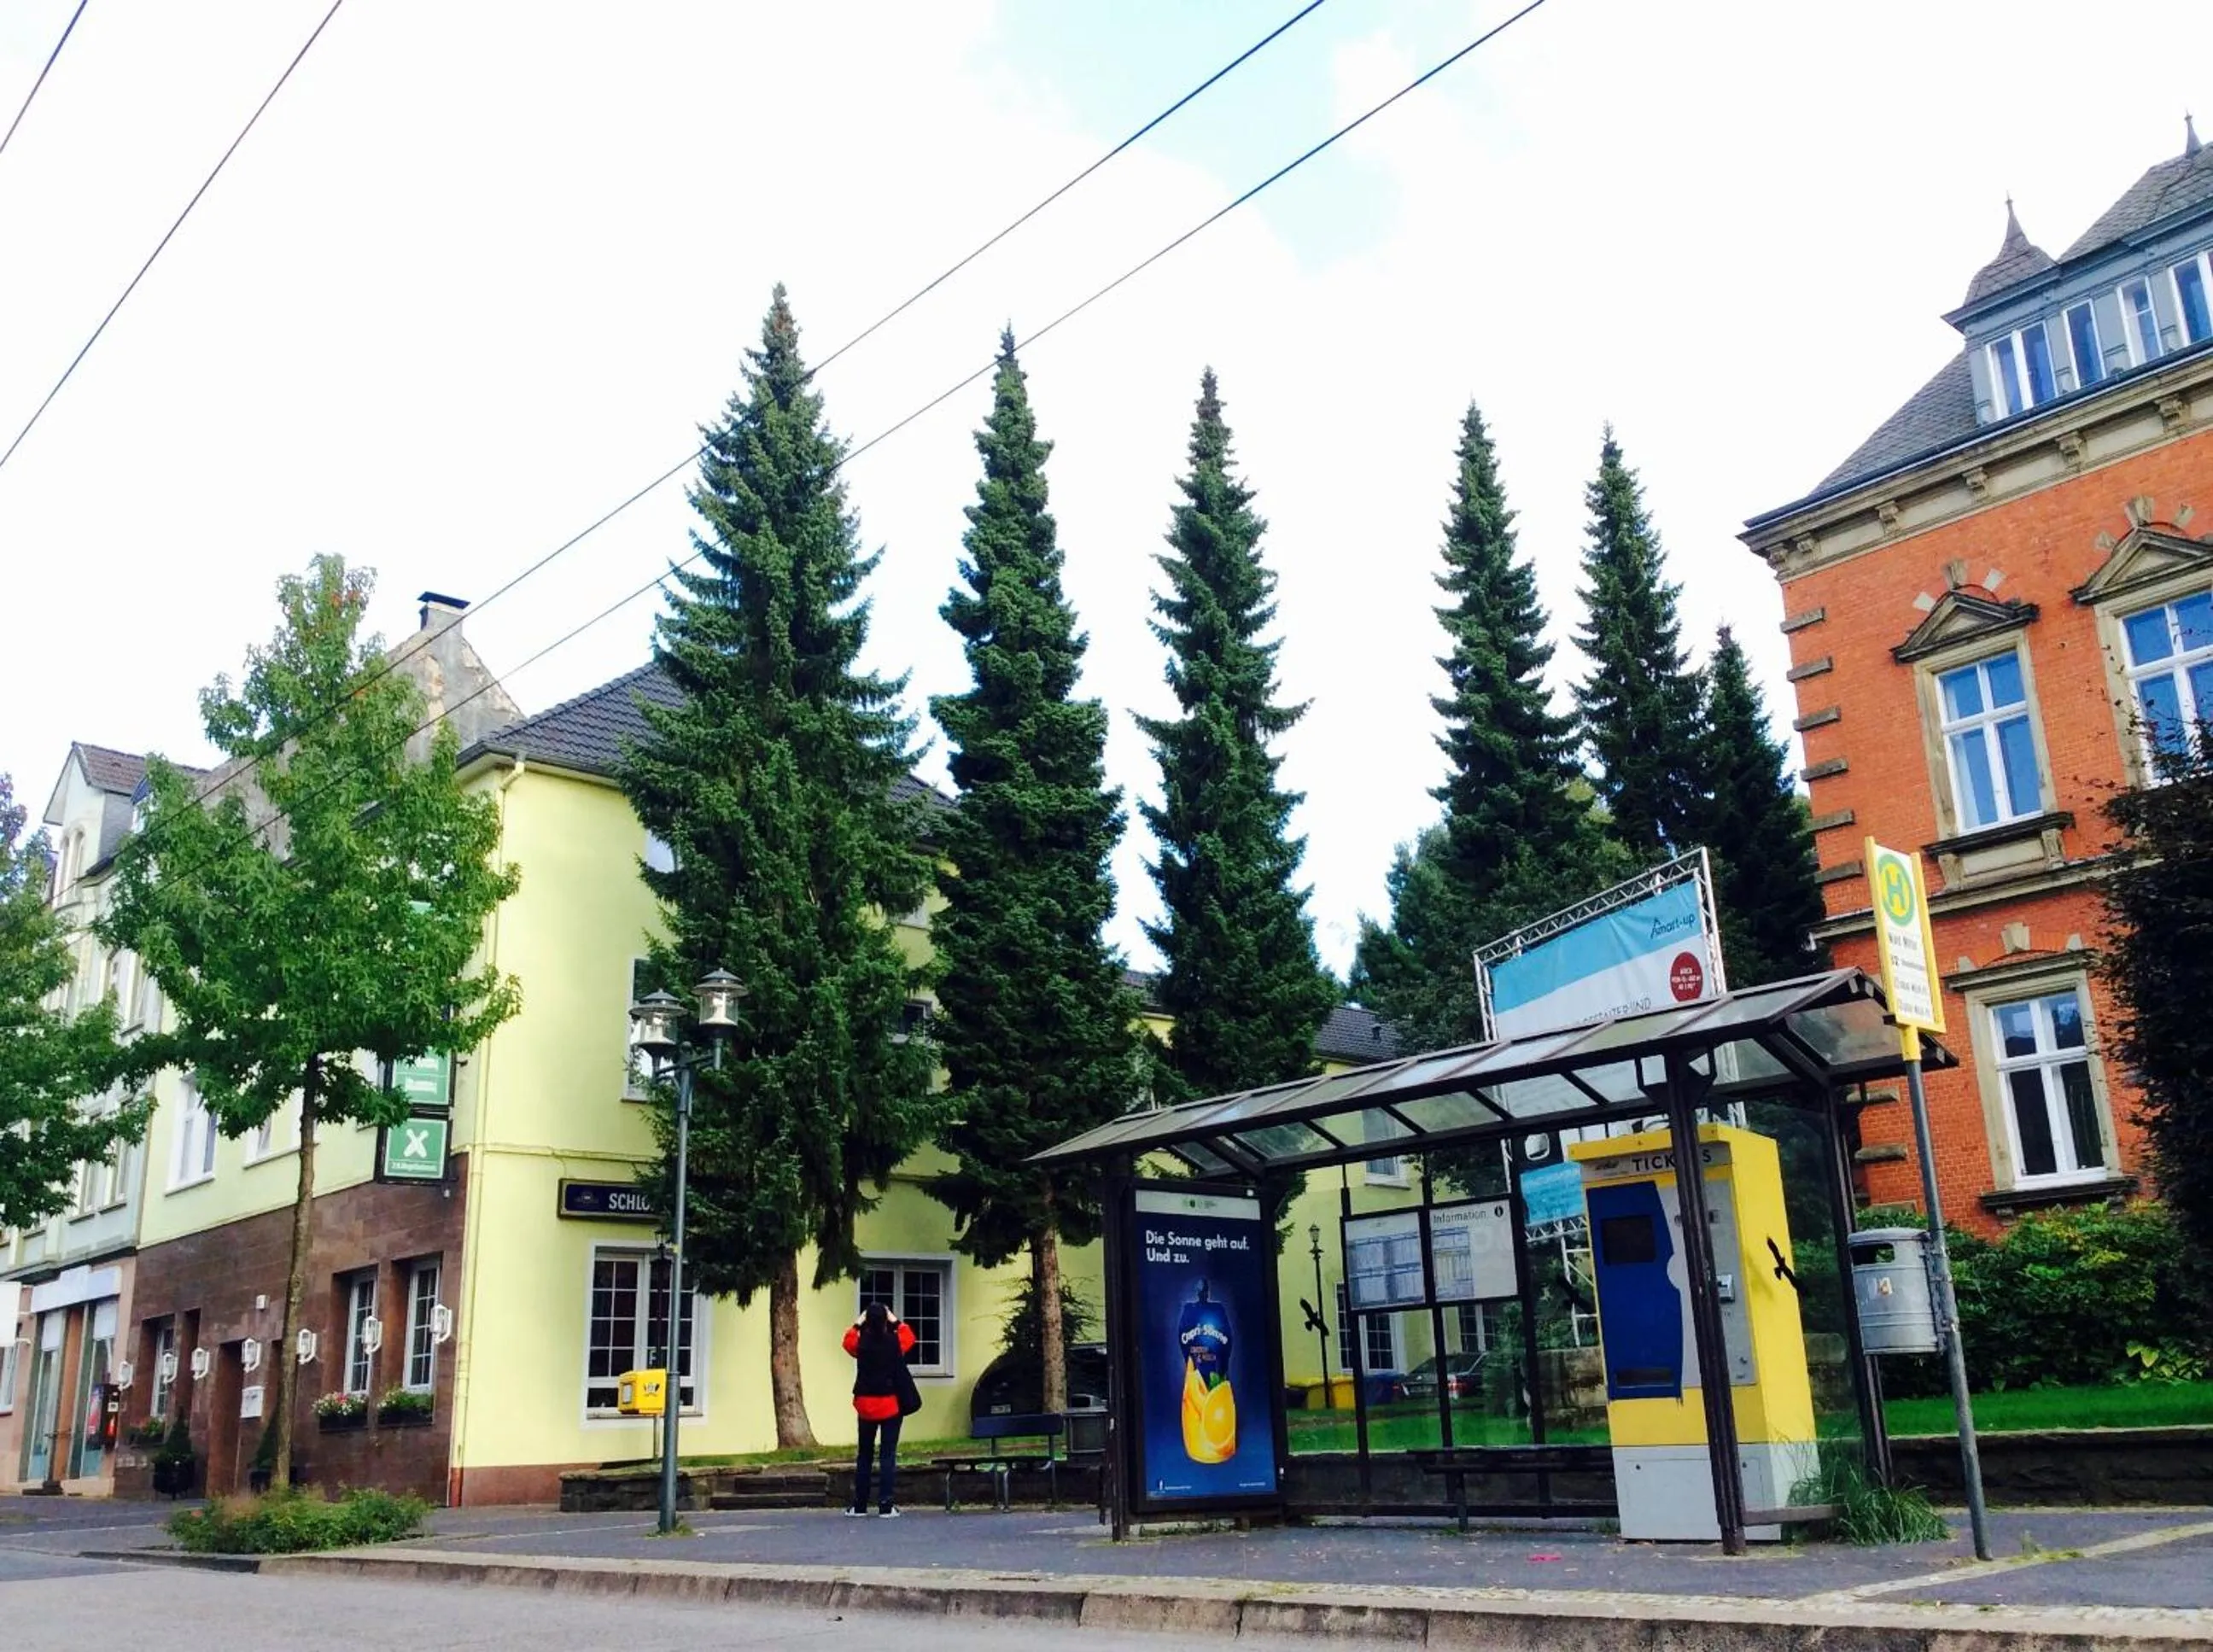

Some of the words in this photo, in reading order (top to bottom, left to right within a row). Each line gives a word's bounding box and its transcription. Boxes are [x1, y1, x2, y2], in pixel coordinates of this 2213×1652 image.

[1886, 868, 1906, 911] H
[1632, 1149, 1712, 1171] TICKS
[1433, 1210, 1487, 1223] Information
[1146, 1230, 1165, 1244] Die
[1168, 1231, 1201, 1246] Sonne
[1205, 1234, 1228, 1251] geht
[1229, 1236, 1250, 1250] auf.
[1147, 1247, 1170, 1262] Und
[1173, 1253, 1189, 1263] zu.
